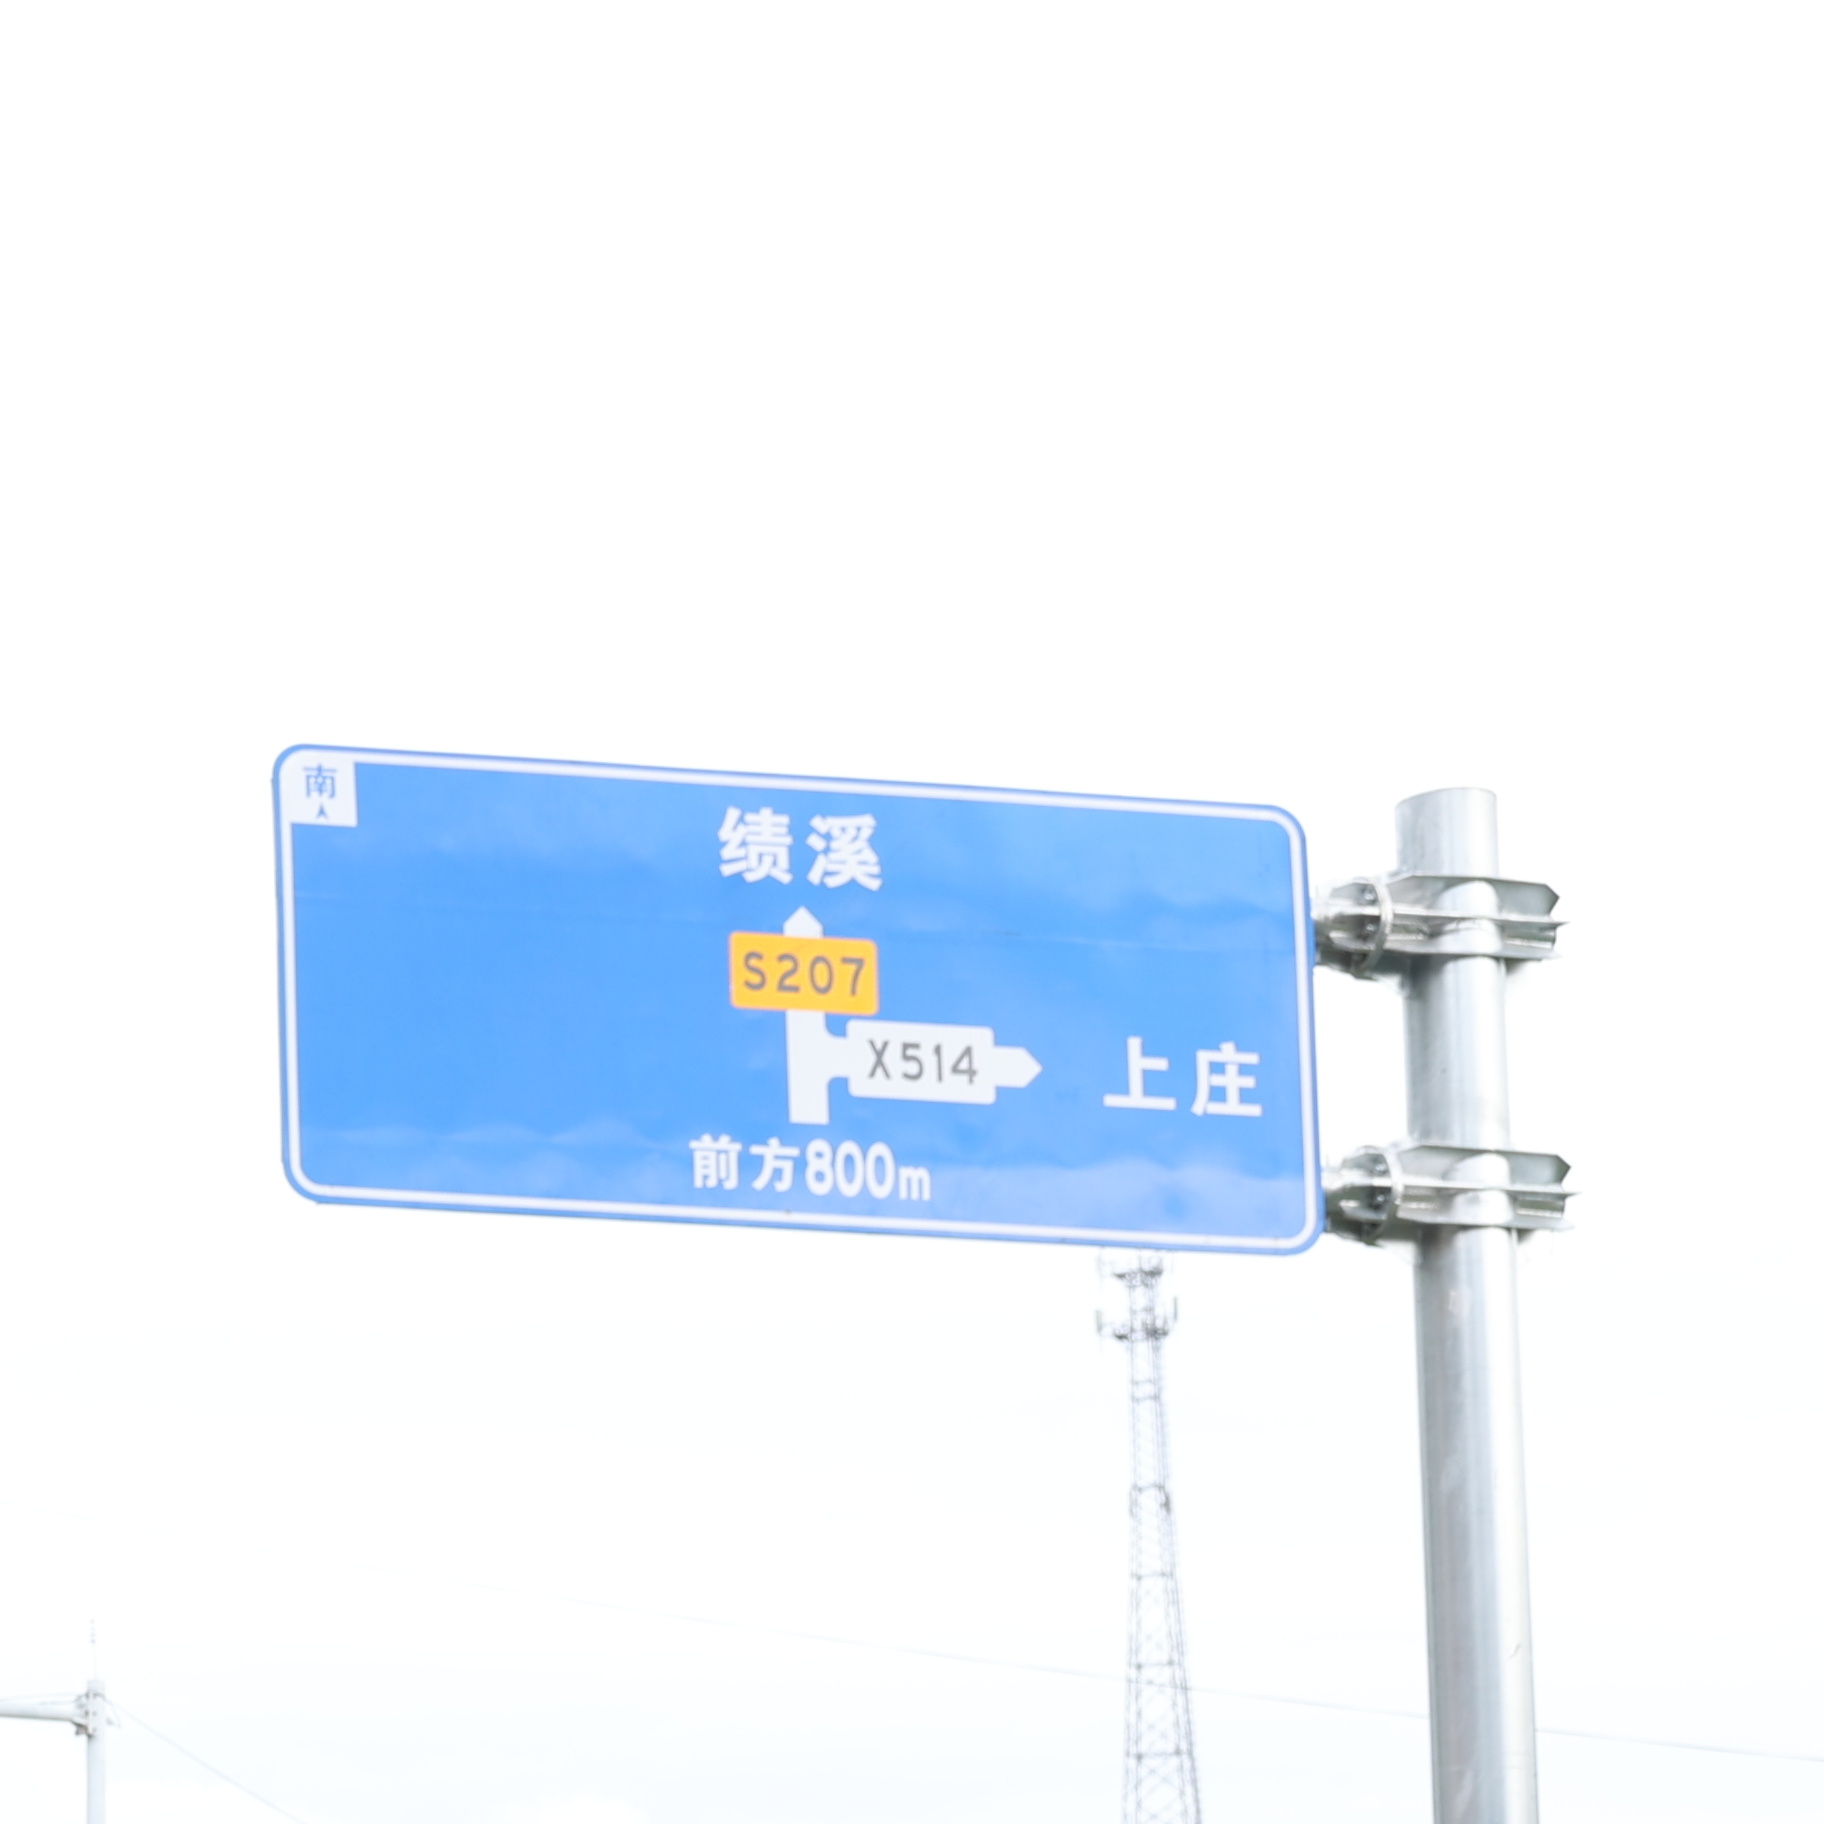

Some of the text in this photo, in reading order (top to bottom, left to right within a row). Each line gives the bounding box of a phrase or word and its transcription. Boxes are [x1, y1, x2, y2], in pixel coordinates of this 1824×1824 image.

[303, 764, 339, 800] 南
[718, 805, 884, 892] 绩溪
[742, 950, 868, 999] S207
[866, 1037, 979, 1086] X514
[1102, 1035, 1263, 1119] 上庄
[688, 1133, 932, 1203] 前方800m
